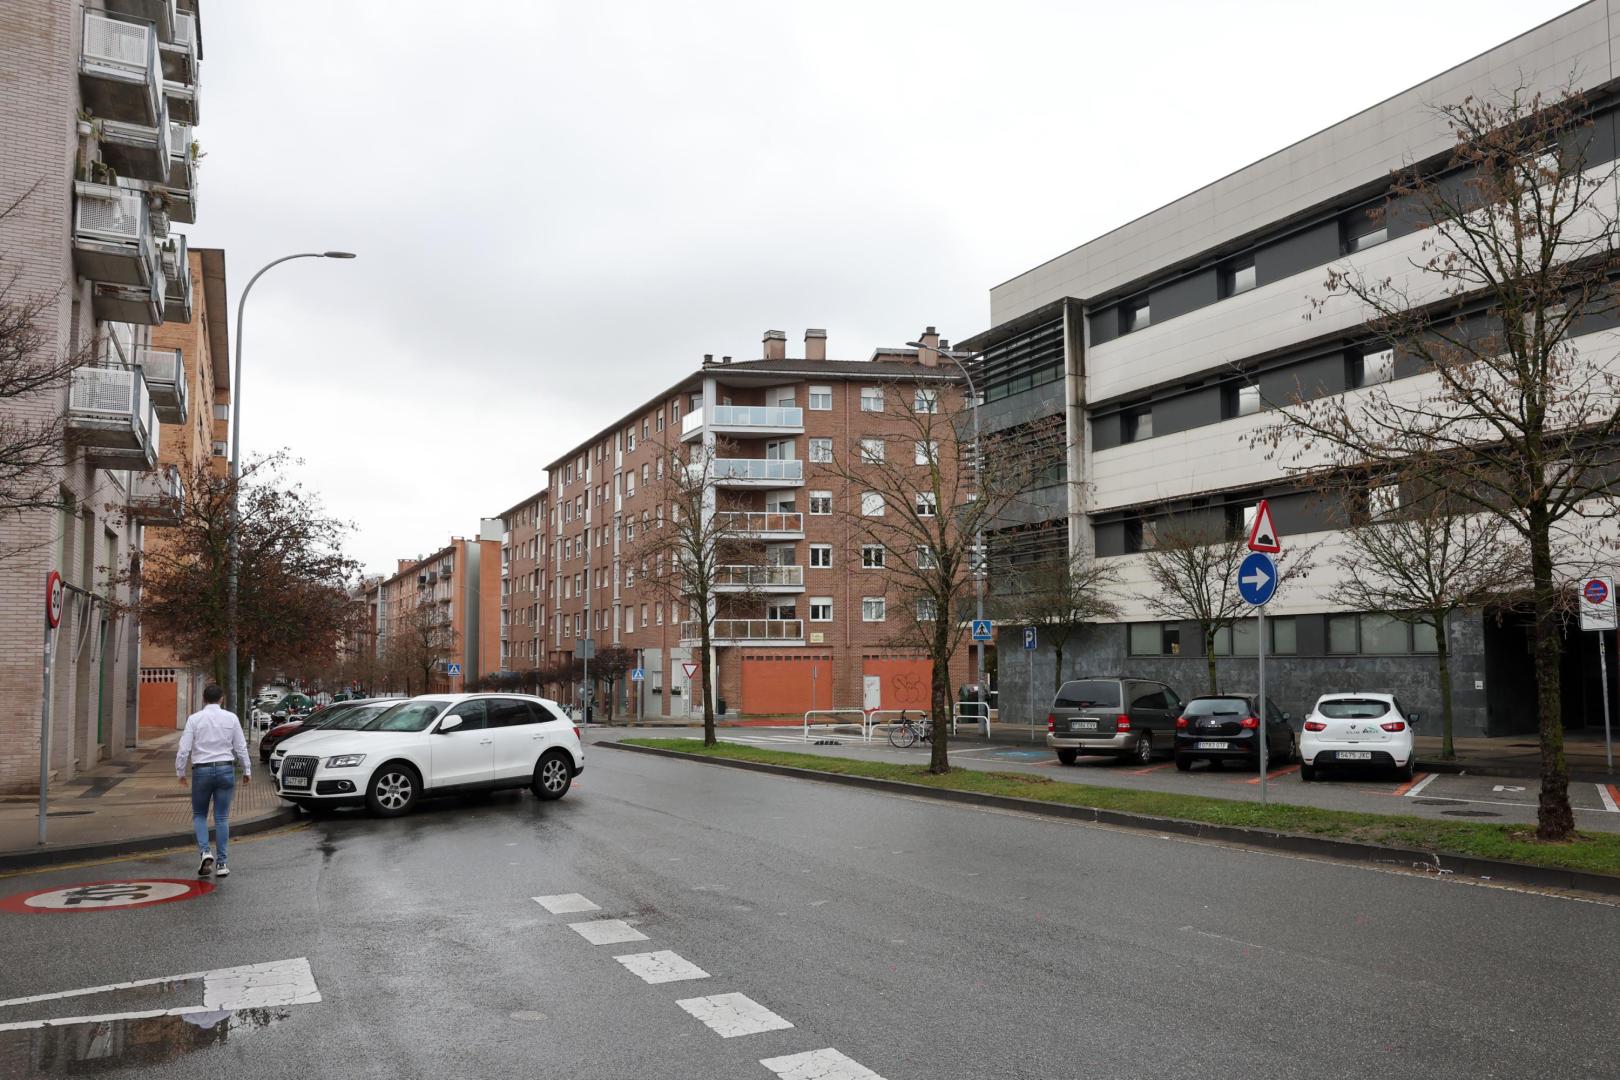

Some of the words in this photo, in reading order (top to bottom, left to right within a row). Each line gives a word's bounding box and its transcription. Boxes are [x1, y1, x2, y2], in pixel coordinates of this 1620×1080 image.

[52, 589, 60, 609] 30
[1025, 630, 1034, 648] P
[62, 884, 153, 905] 30
